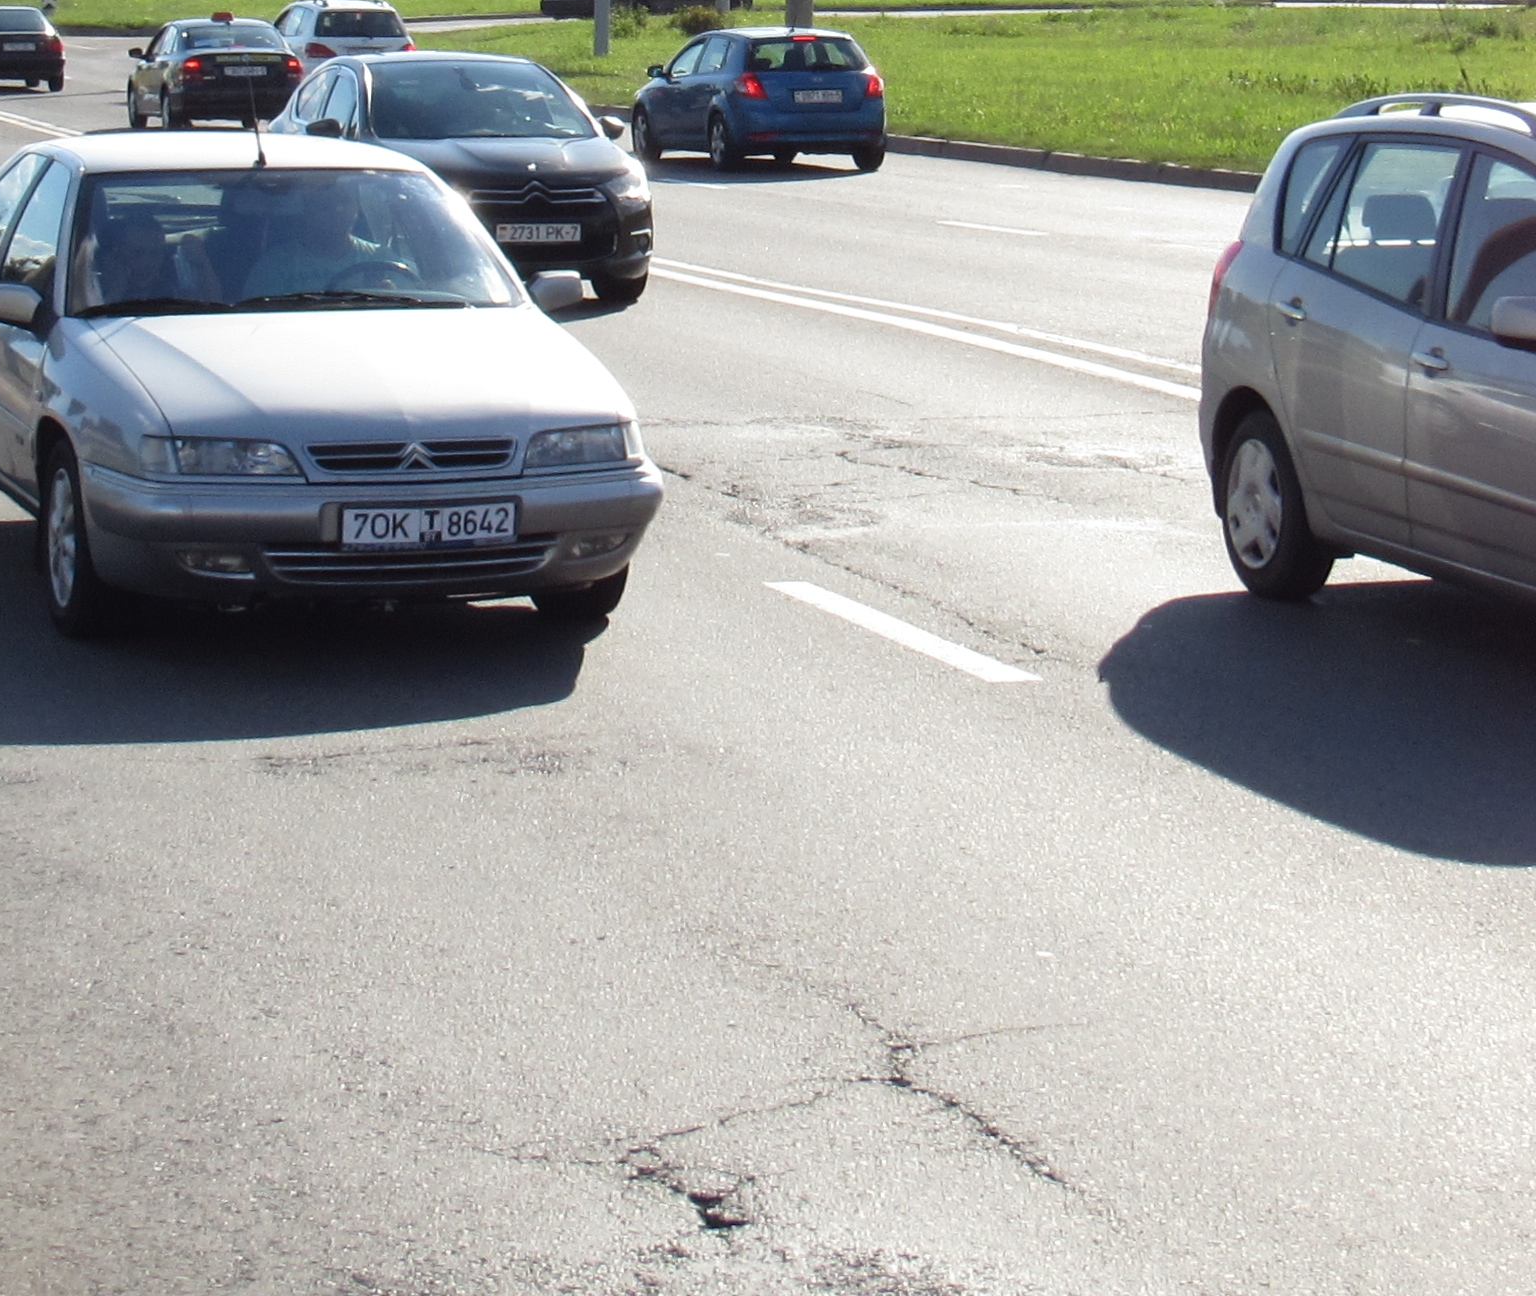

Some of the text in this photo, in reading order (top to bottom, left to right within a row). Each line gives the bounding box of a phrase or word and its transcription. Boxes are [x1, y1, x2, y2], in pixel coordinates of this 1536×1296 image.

[509, 226, 579, 240] 2731 PK-7
[447, 507, 509, 536] 8642
